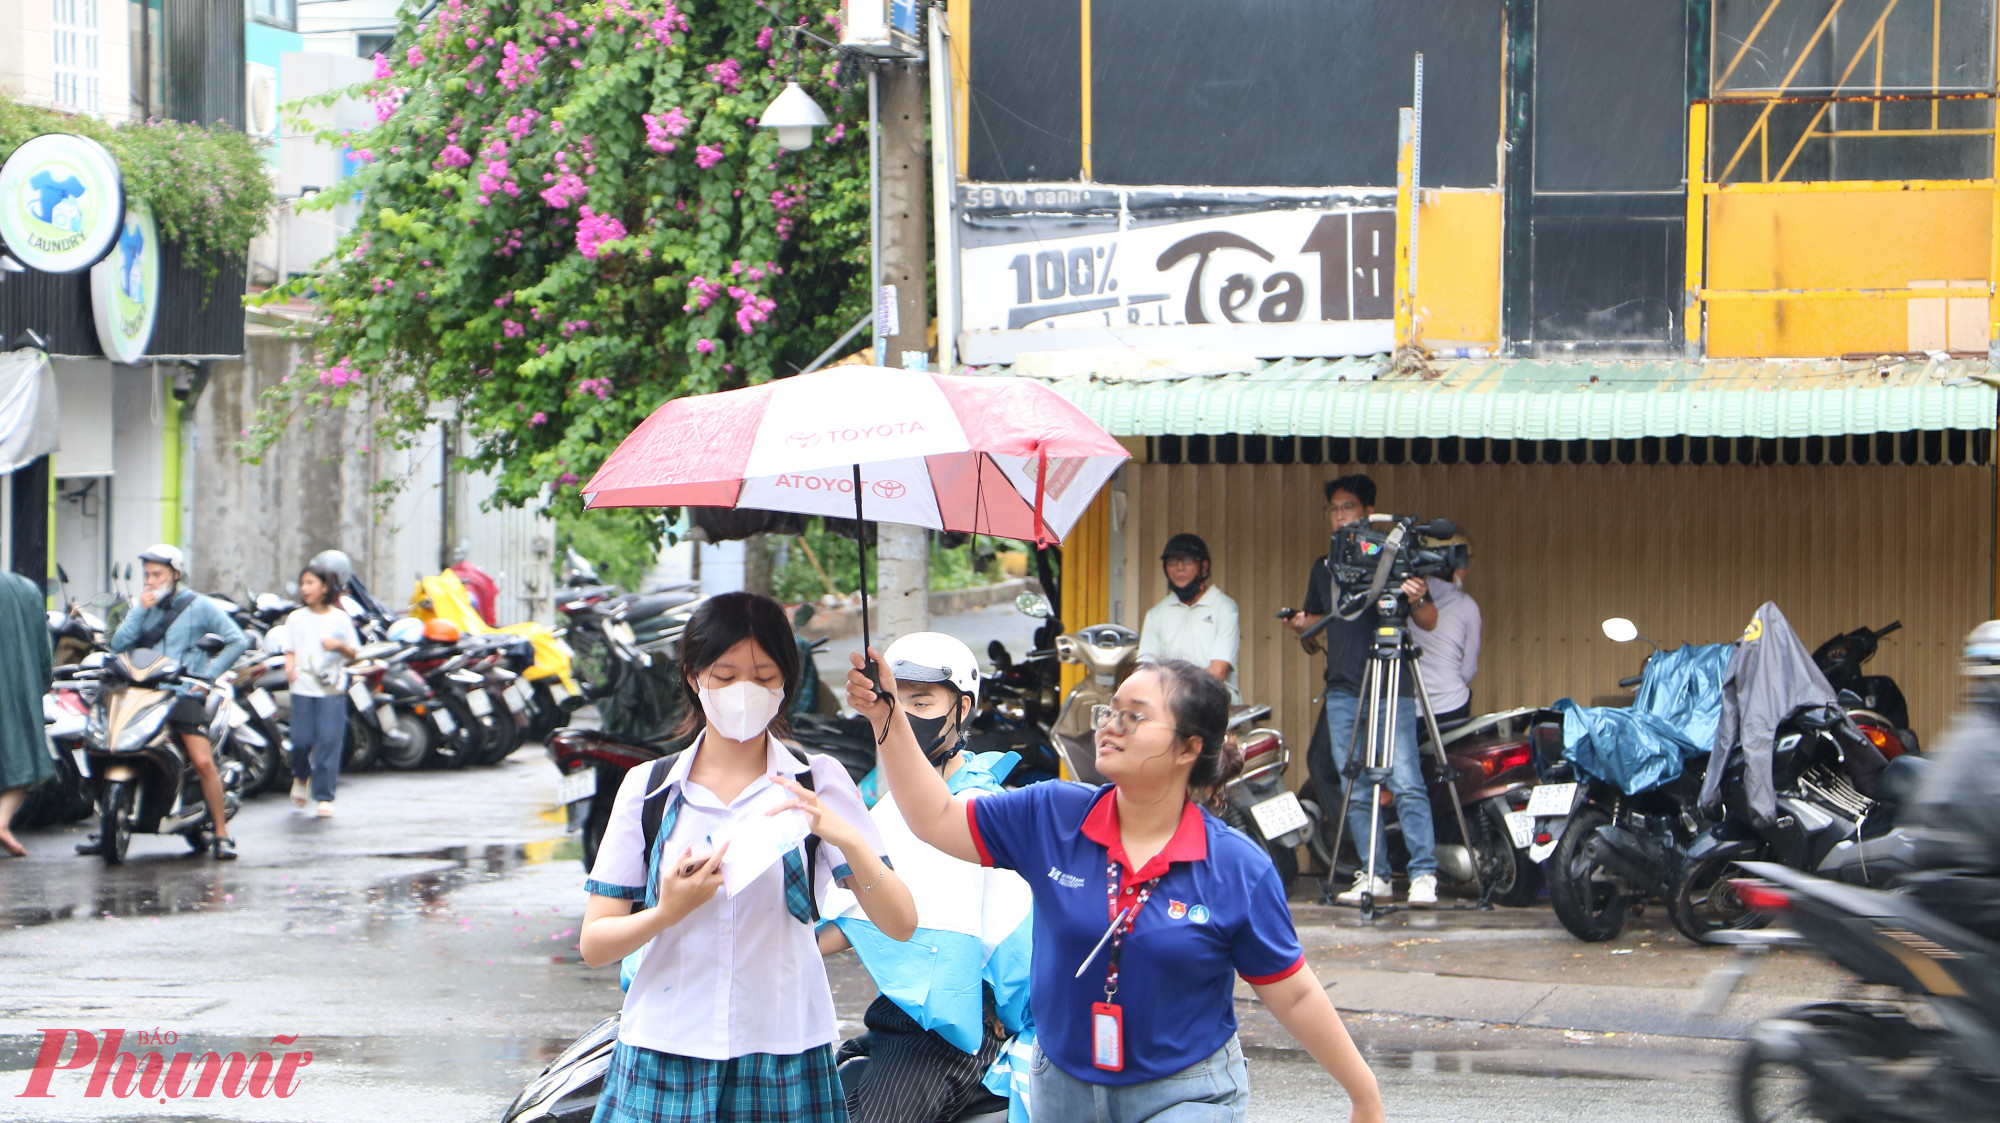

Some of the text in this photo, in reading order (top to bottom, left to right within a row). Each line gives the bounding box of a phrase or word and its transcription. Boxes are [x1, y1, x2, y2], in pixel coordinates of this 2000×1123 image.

[964, 188, 995, 208] 59
[27, 231, 86, 252] LAUNDRY
[1008, 242, 1118, 305] 100%
[826, 421, 925, 443] TOYOTA
